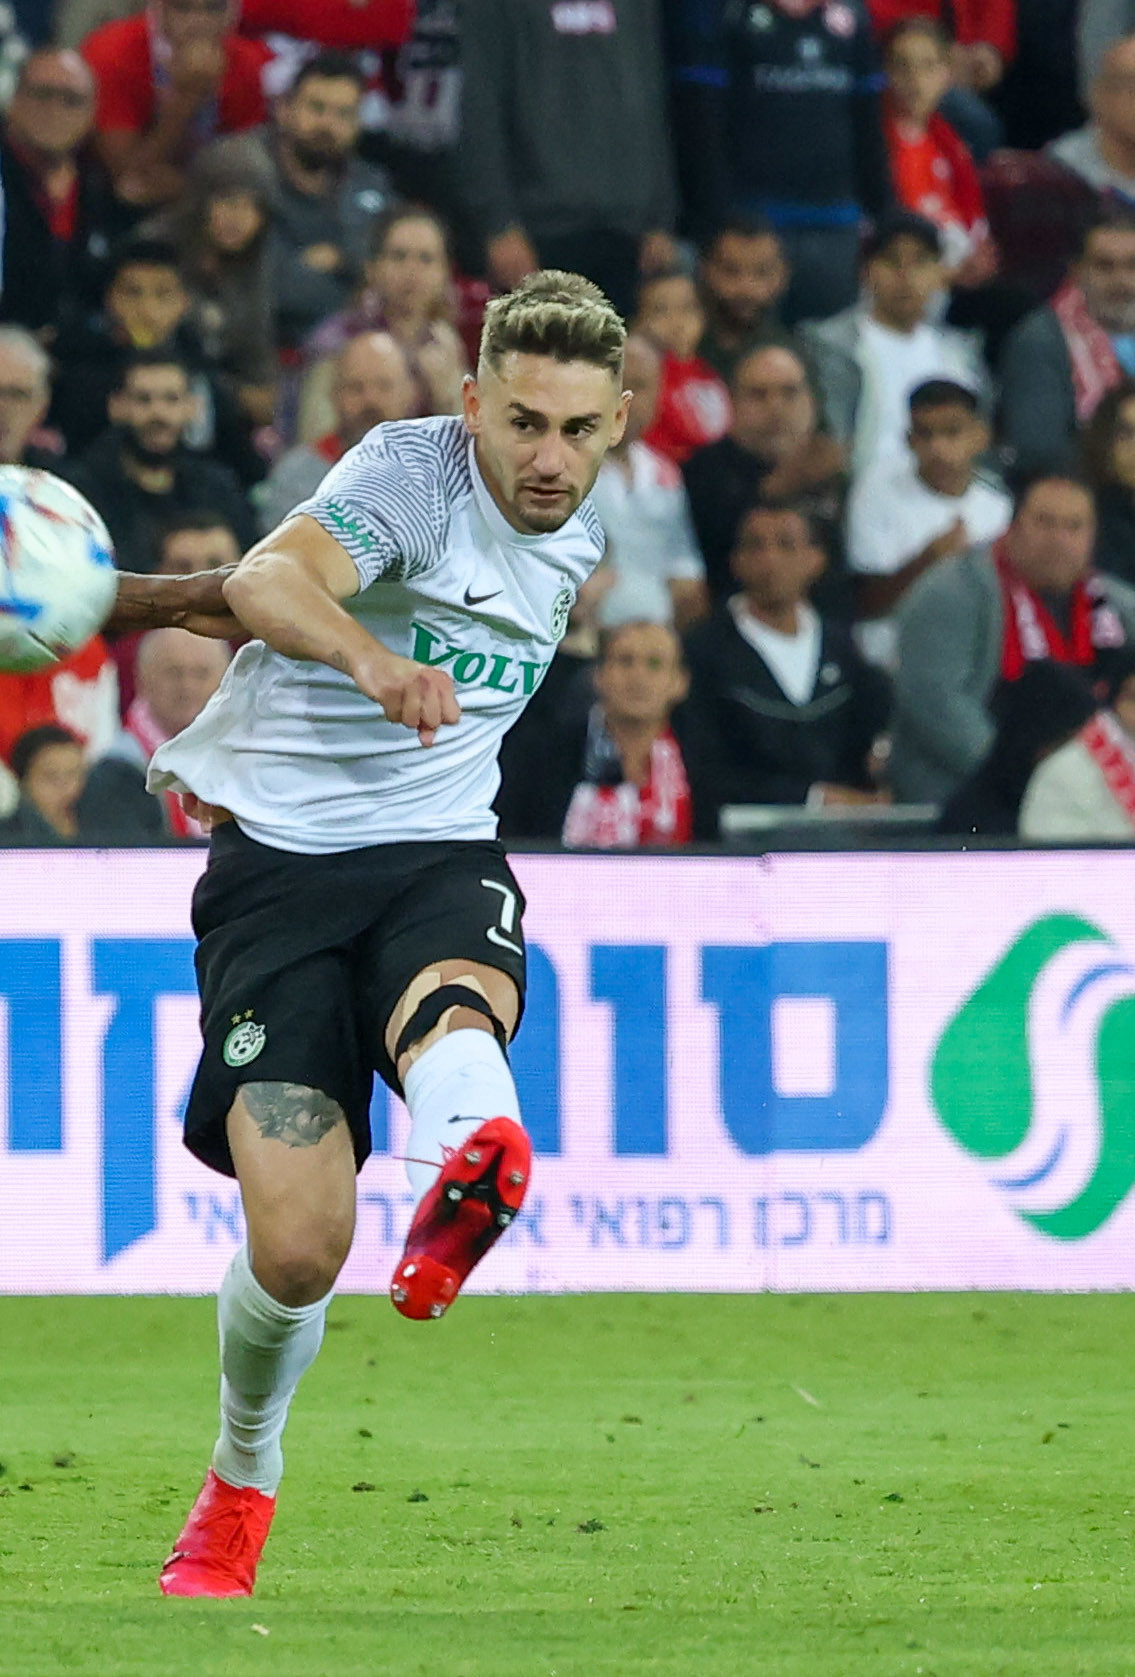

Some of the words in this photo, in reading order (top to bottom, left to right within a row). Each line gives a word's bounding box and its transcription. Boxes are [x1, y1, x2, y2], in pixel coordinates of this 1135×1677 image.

[480, 879, 516, 934] 7
[567, 1190, 732, 1249] רפואי
[753, 1188, 892, 1249] מרכז
